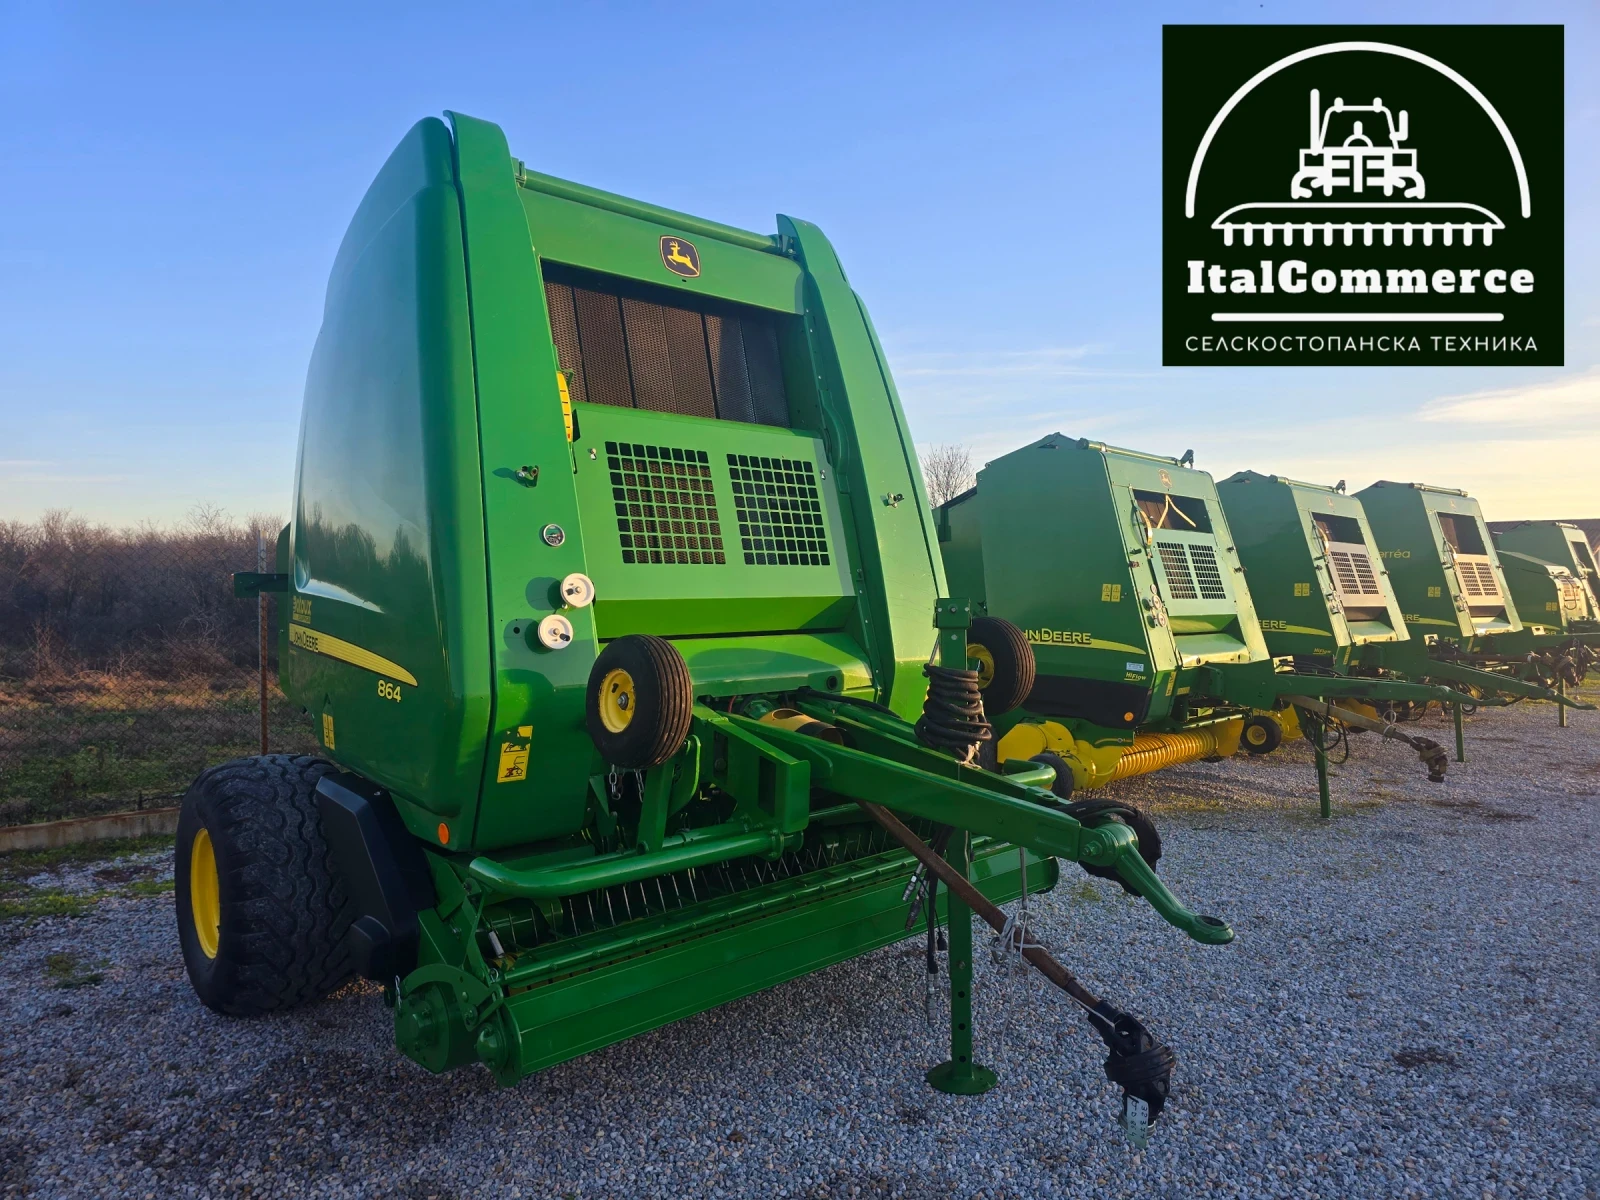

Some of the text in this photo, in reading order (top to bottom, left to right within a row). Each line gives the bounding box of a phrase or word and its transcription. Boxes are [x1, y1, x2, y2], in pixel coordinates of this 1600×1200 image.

[1379, 548, 1411, 559] erréa
[1041, 627, 1092, 643] DEERE
[377, 679, 402, 703] 864
